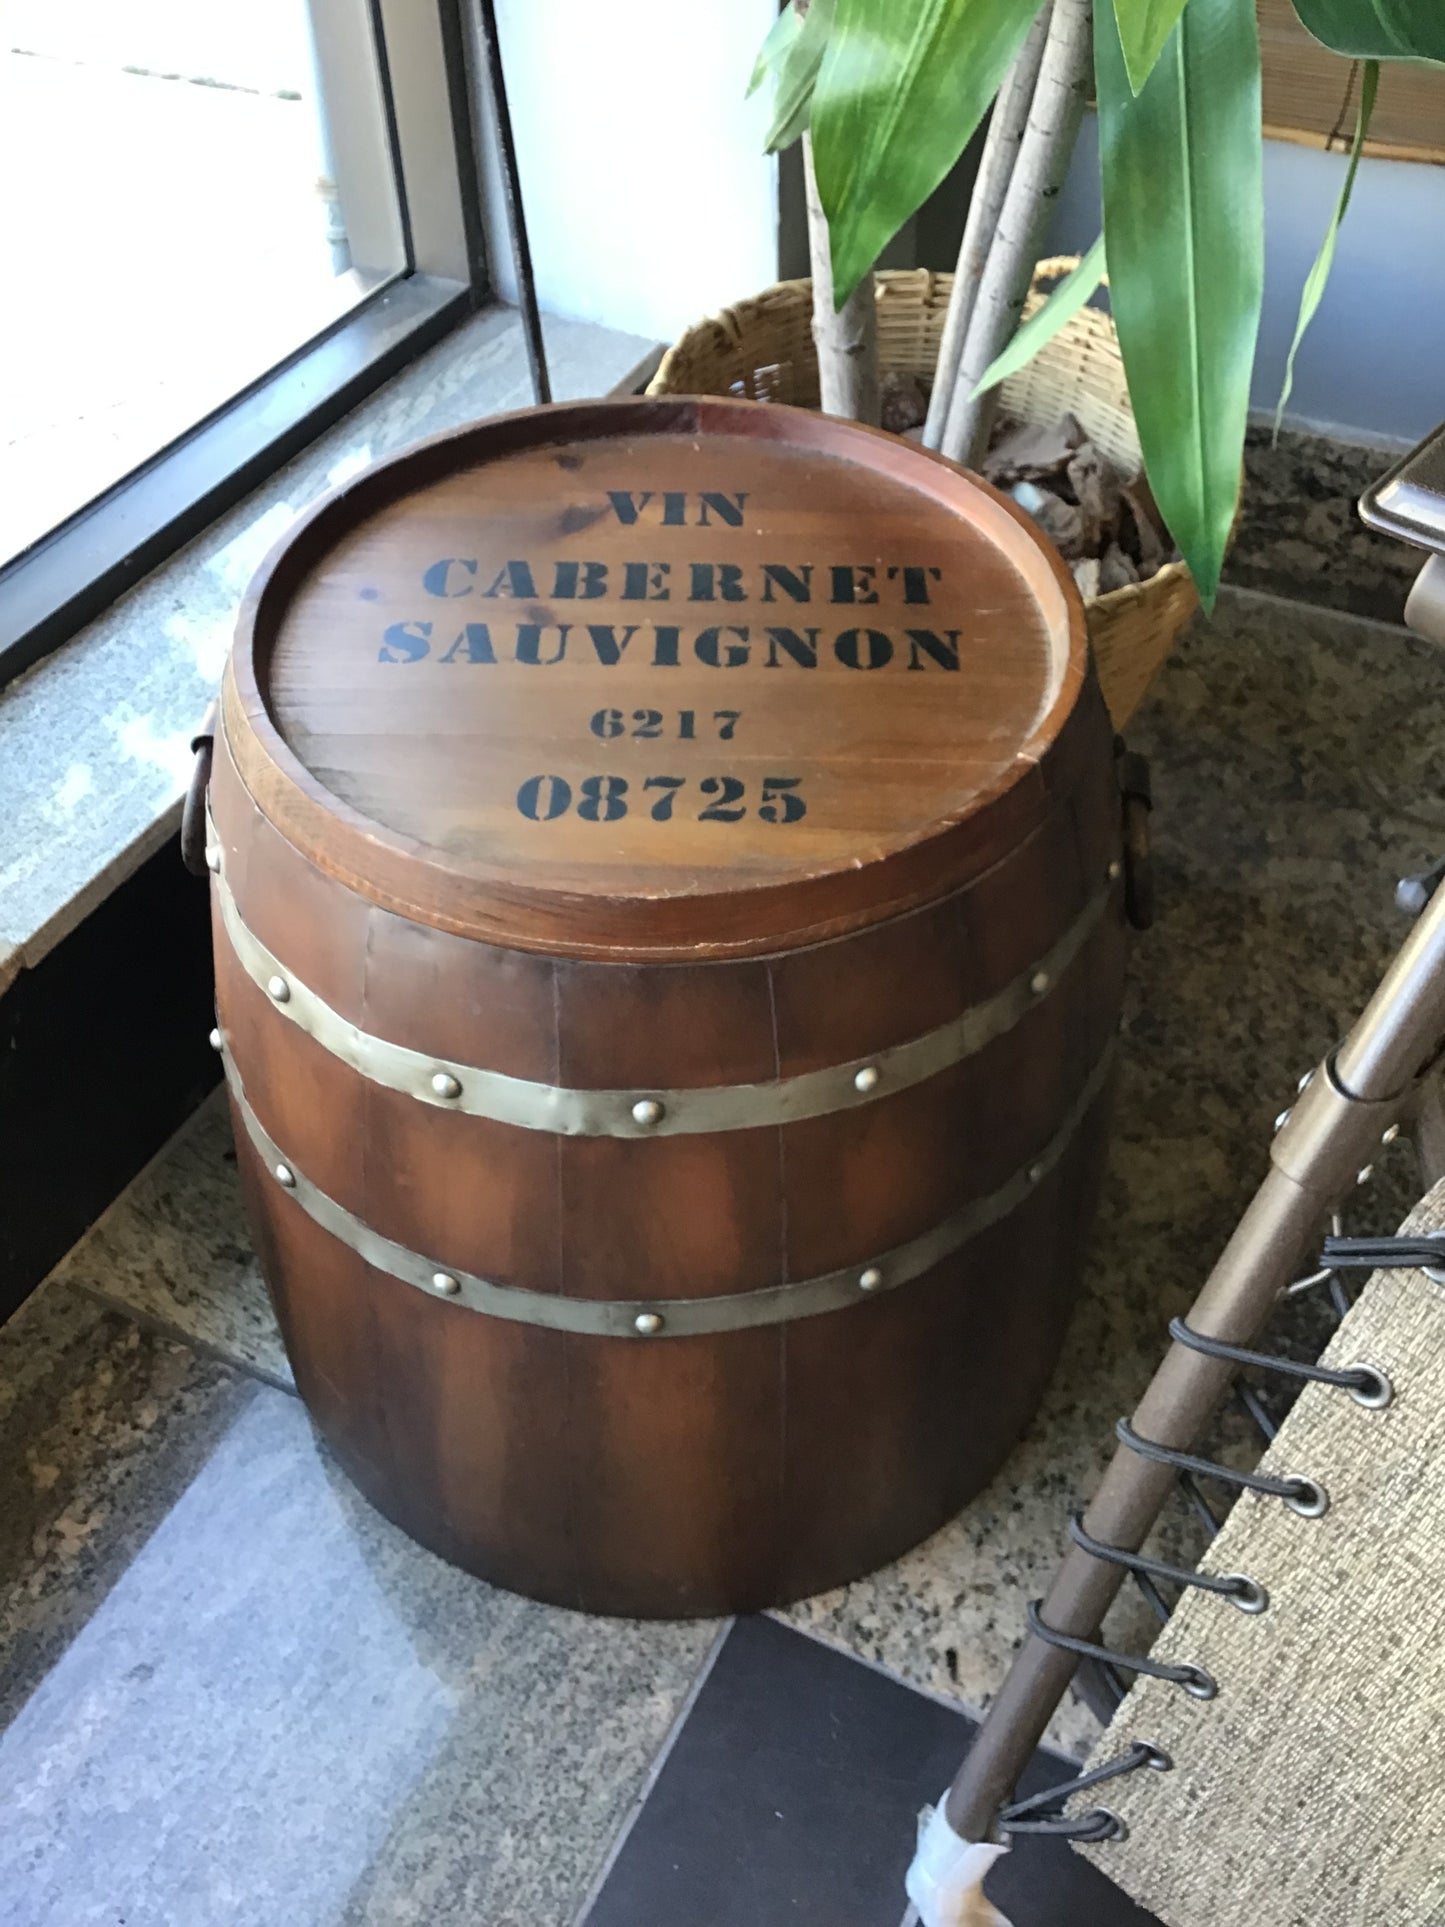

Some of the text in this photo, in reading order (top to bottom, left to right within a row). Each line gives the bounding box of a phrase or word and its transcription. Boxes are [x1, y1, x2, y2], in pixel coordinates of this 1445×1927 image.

[606, 491, 750, 526] VIN
[422, 559, 943, 605] CABERNET
[377, 621, 963, 672] SAUVIGNON
[590, 708, 743, 740] 6217
[516, 775, 807, 824] 08725
